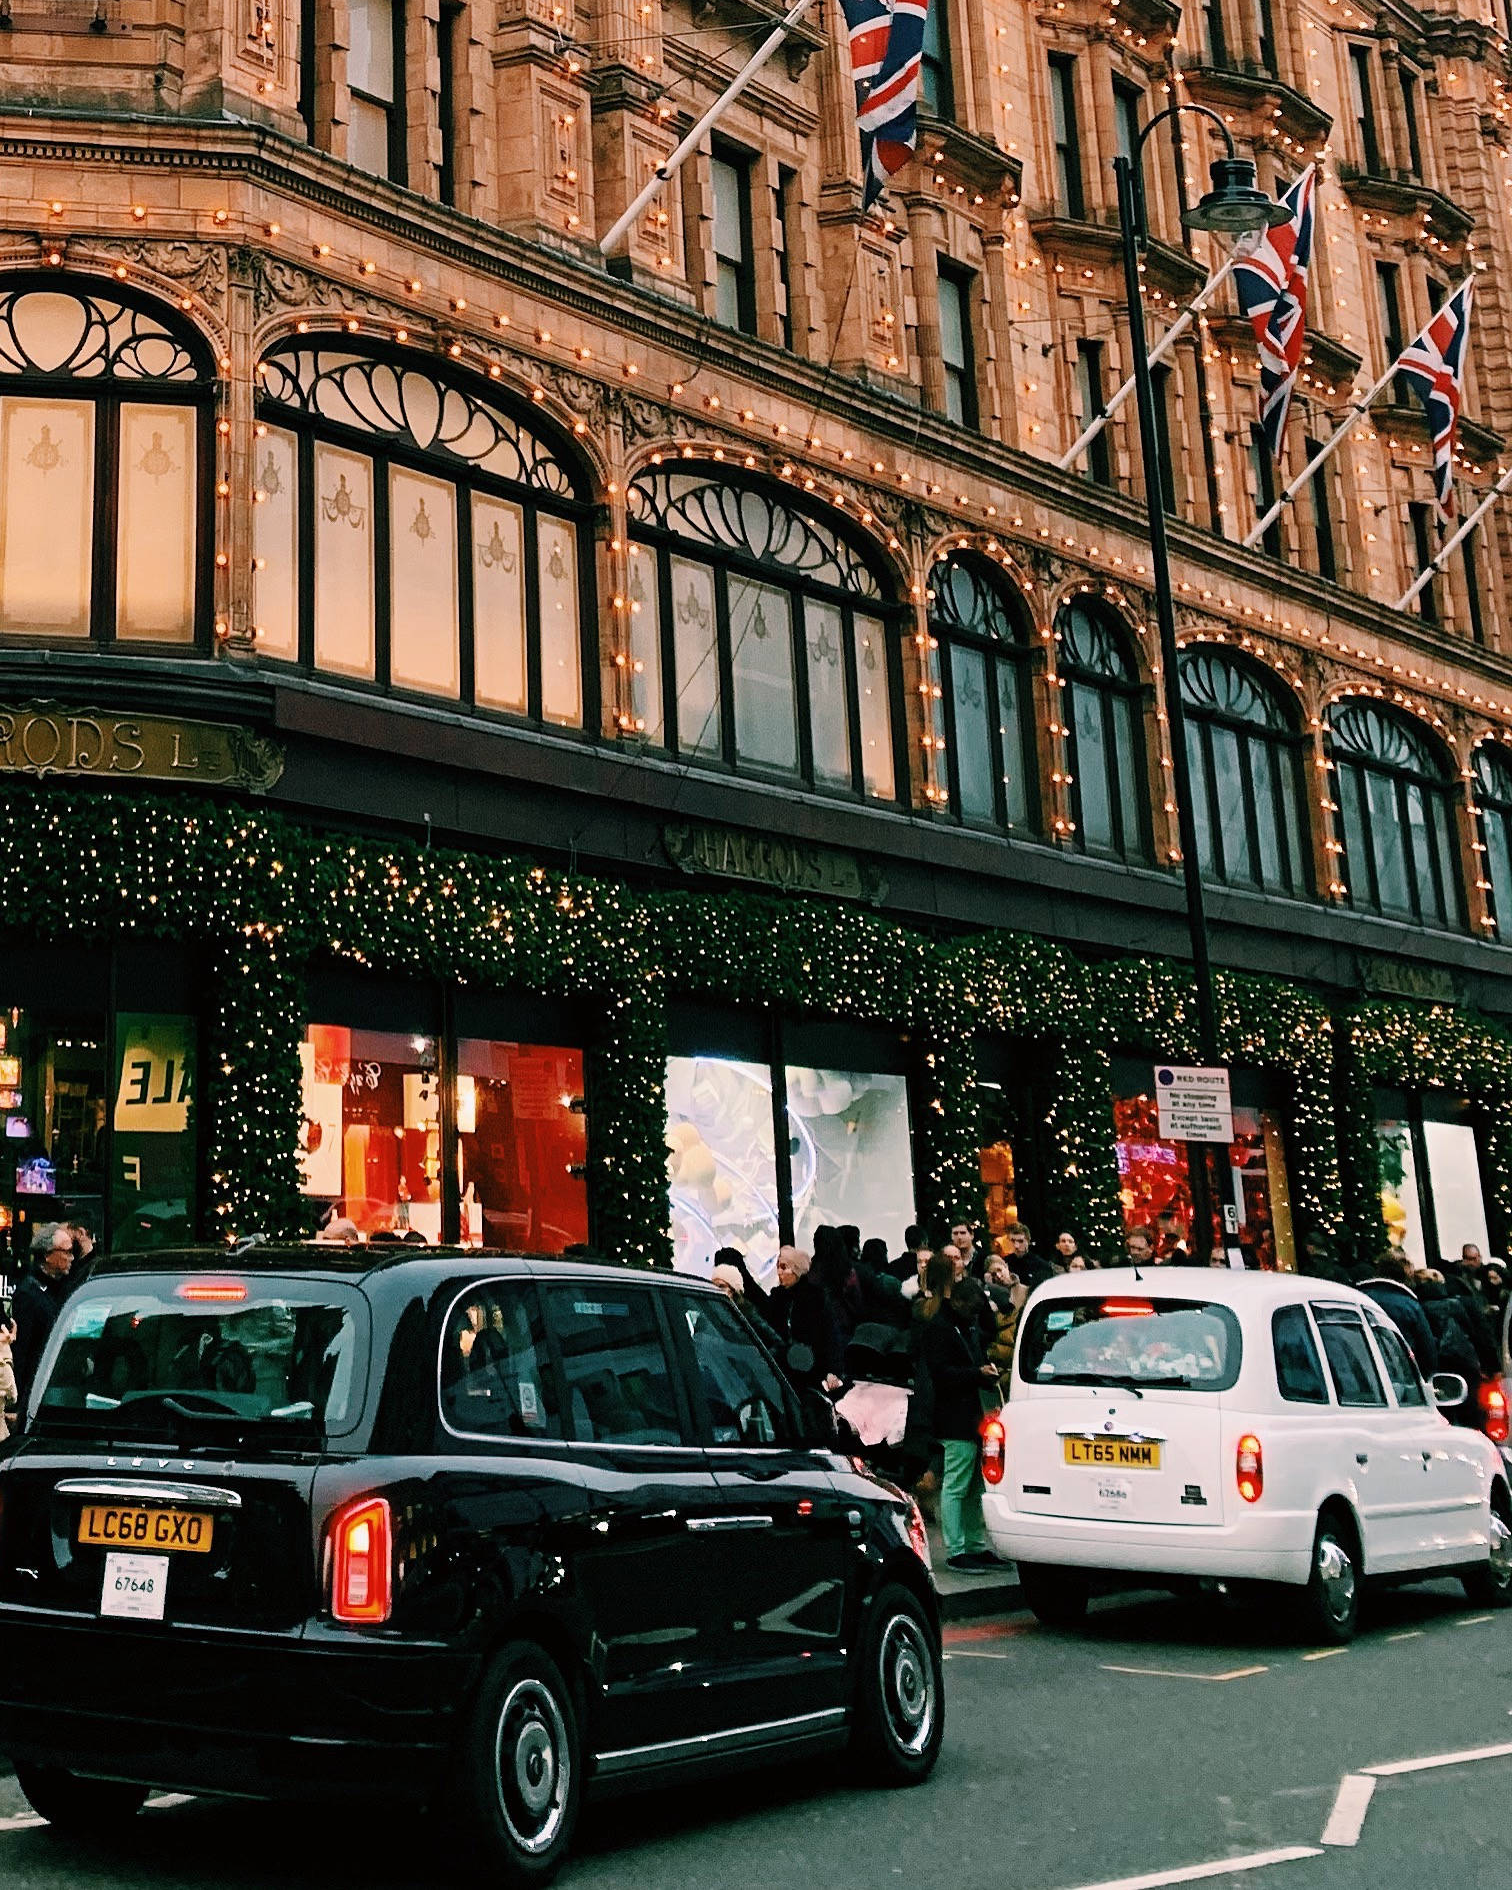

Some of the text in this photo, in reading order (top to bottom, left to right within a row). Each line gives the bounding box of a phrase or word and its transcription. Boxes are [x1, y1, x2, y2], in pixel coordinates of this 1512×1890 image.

[1071, 1443, 1152, 1464] LT65 NMM
[88, 1510, 203, 1545] LC68 GXO
[115, 1576, 154, 1593] 67648
